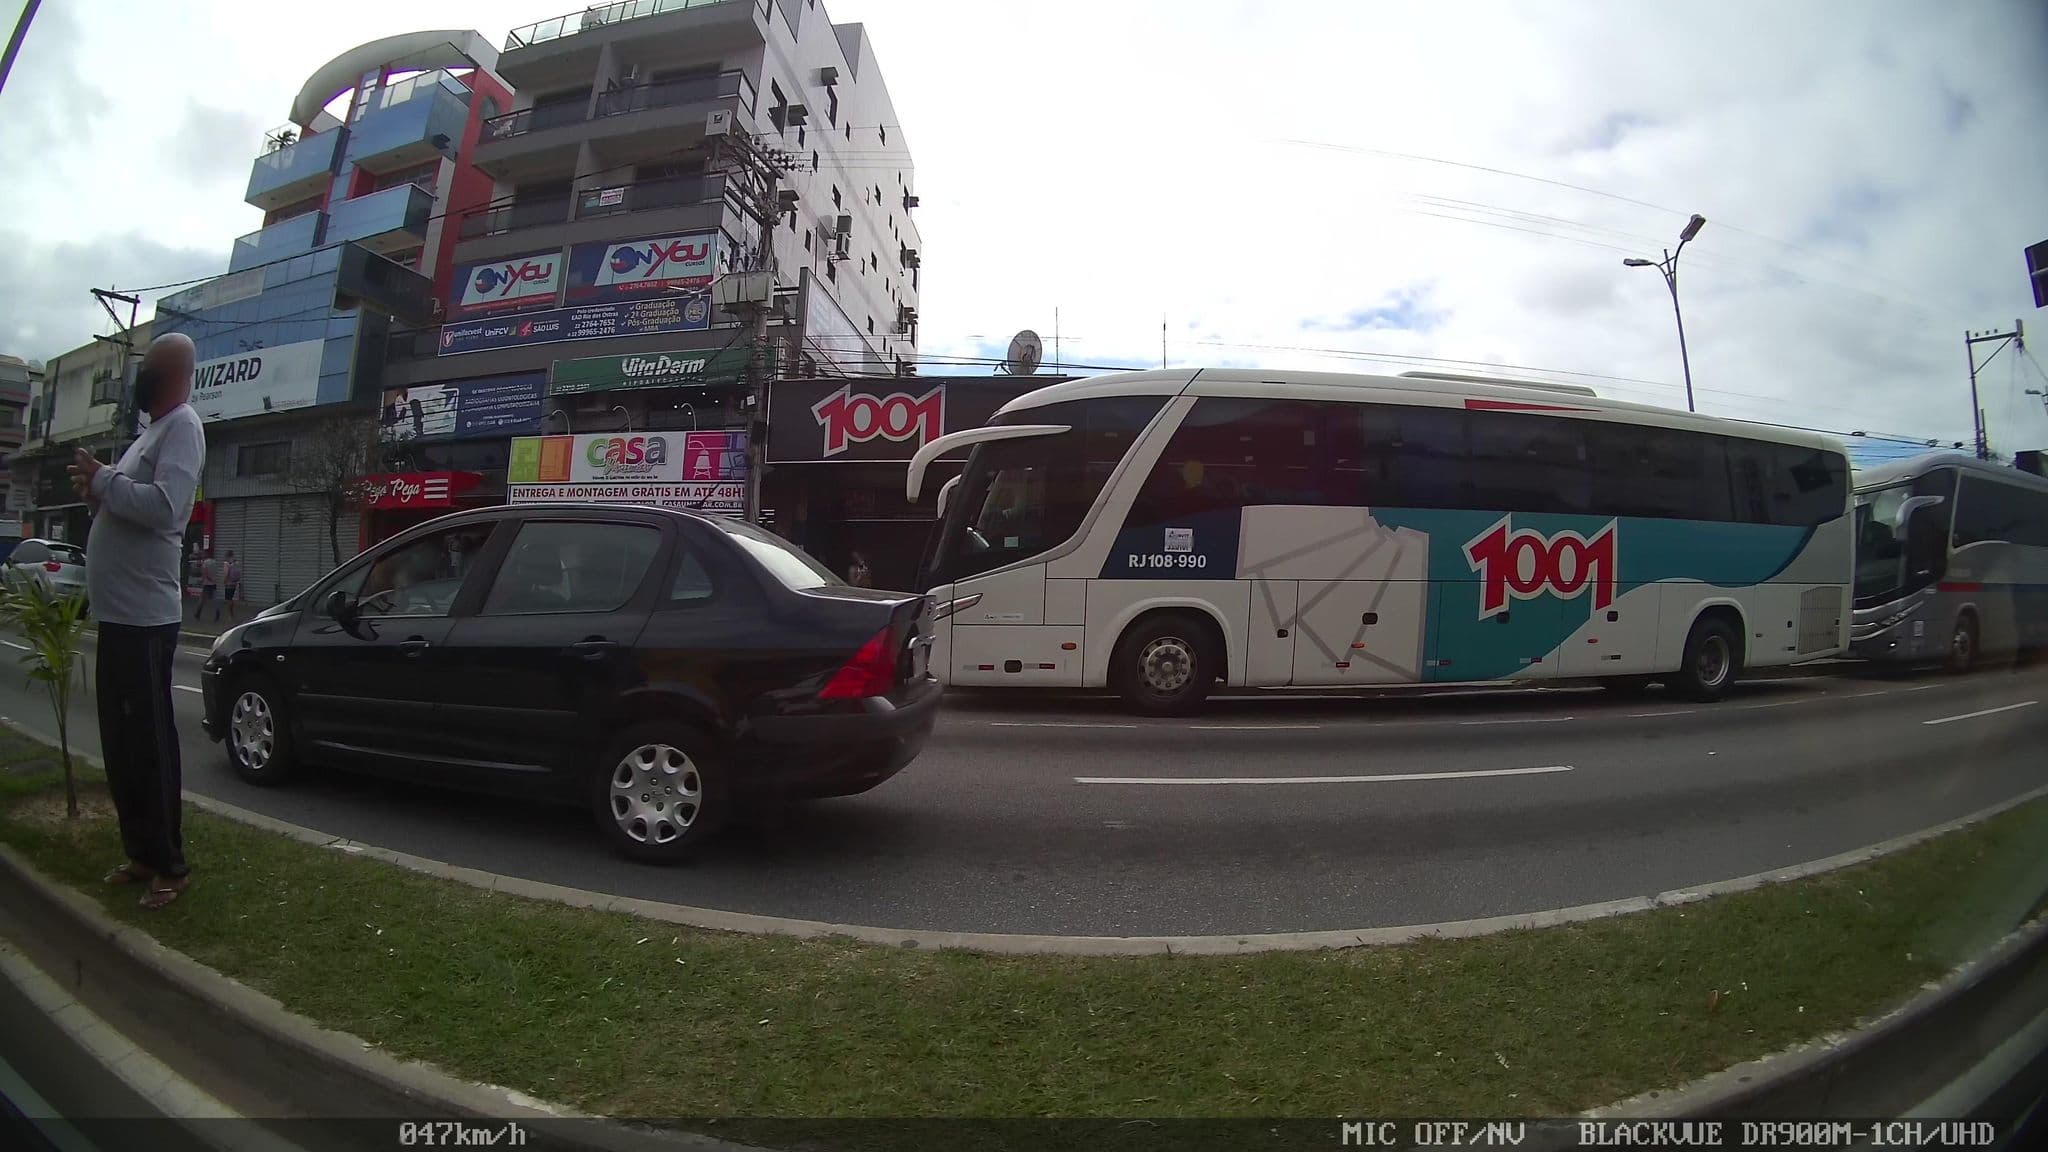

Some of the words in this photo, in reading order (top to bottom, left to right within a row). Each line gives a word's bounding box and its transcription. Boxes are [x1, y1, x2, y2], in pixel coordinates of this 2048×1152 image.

[635, 300, 676, 310] Graduação
[640, 308, 679, 318] Graduação
[581, 319, 616, 328] 2764-7652
[627, 315, 681, 326] Pós-Graduação
[578, 327, 616, 336] 99965-2476
[195, 357, 262, 390] WIZARD
[811, 383, 946, 457] 1001
[587, 436, 668, 467] casa
[390, 479, 421, 503] Pega
[513, 488, 556, 498] ENTREGA
[559, 488, 565, 497] E
[567, 487, 628, 497] MONTAGEM
[674, 487, 690, 497] EM
[1461, 513, 1617, 621] 1001
